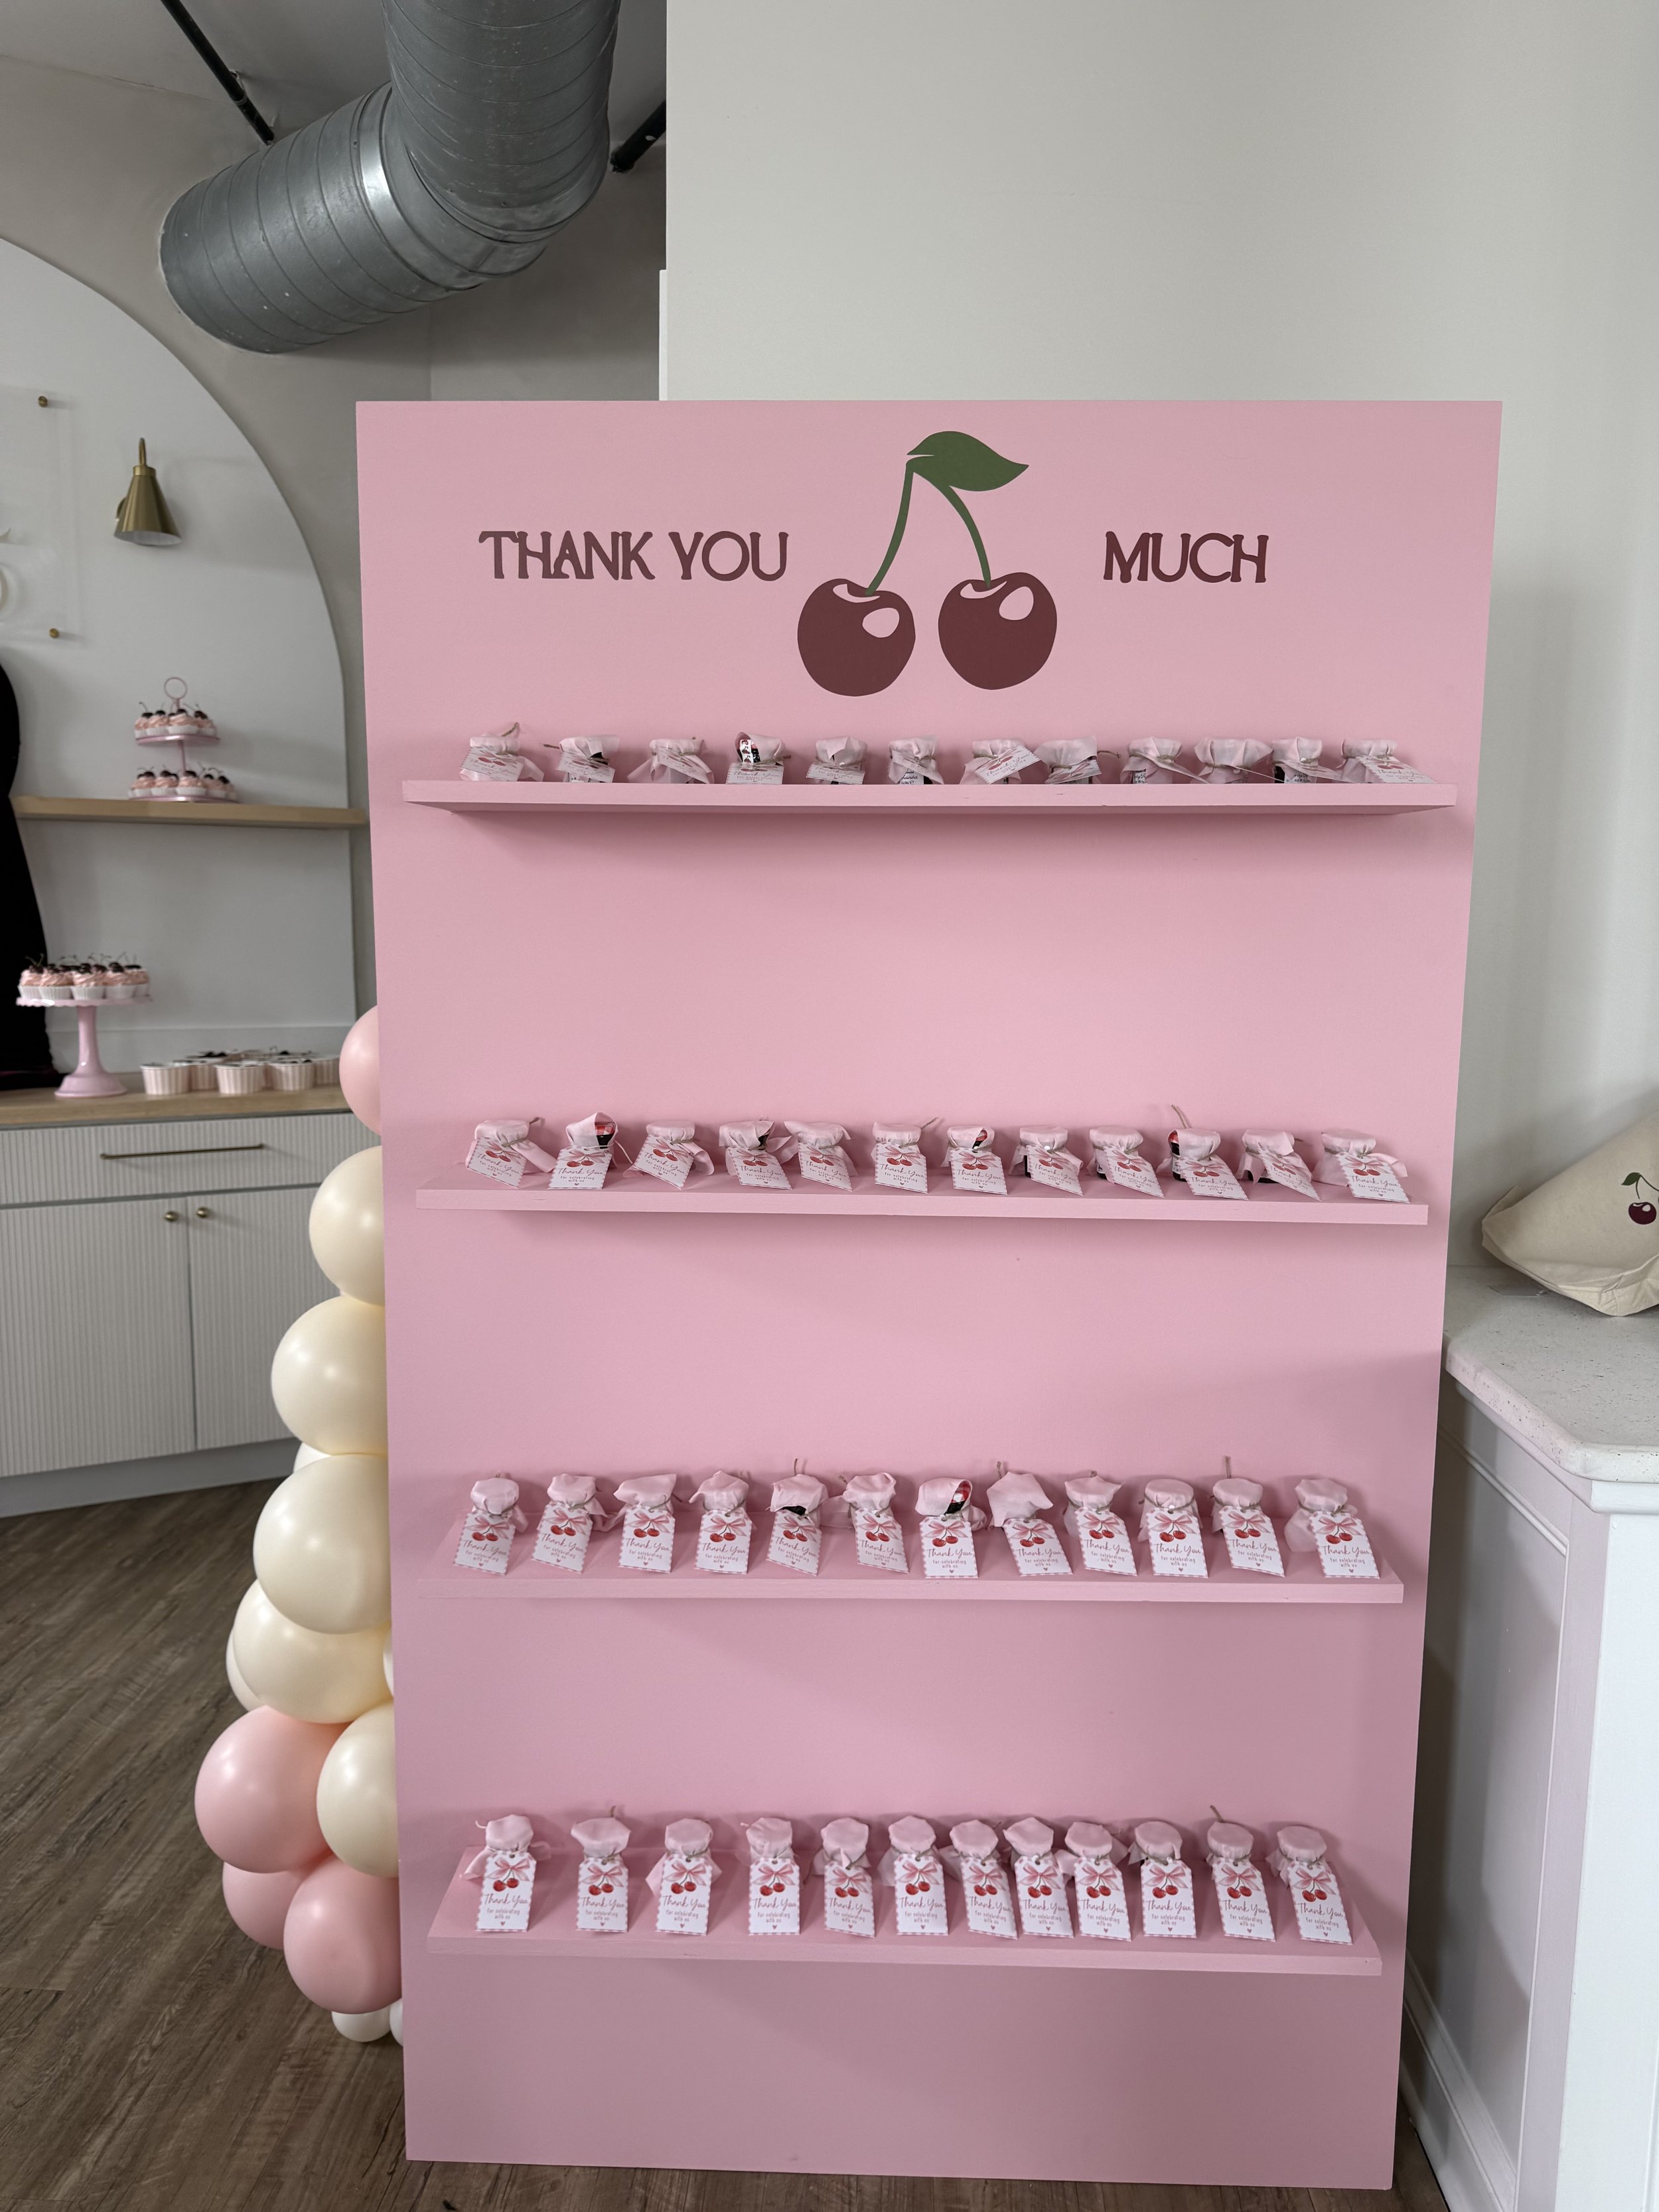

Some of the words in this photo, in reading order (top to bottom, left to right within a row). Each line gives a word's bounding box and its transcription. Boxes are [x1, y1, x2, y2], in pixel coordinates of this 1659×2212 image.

[478, 531, 655, 580] THANK
[668, 531, 788, 581] YOU
[1104, 532, 1269, 583] MUCH
[463, 1540, 488, 1550] Thank
[490, 1546, 506, 1555] You
[541, 1532, 566, 1546] Thank
[568, 1542, 583, 1551] You
[625, 1537, 652, 1548] Thank
[654, 1542, 670, 1552] You
[701, 1542, 728, 1552] Thank
[730, 1546, 746, 1555] You
[775, 1536, 800, 1549] Thank
[801, 1546, 816, 1556] You
[859, 1540, 885, 1551] Thank
[887, 1547, 902, 1556] You
[1084, 1538, 1111, 1550] Thank
[1113, 1544, 1129, 1554] You
[1153, 1542, 1182, 1553] Thank
[1184, 1546, 1200, 1556] You
[1230, 1538, 1258, 1549] Thank
[1260, 1543, 1276, 1552] You
[926, 1548, 953, 1557] Thank
[955, 1548, 972, 1558] You
[1015, 1548, 1043, 1556] Thank
[1045, 1548, 1061, 1557] You
[1321, 1545, 1350, 1554] Thank
[1352, 1546, 1369, 1557] You
[484, 1893, 510, 1904] Thank
[512, 1895, 528, 1907] You
[581, 1896, 607, 1907] Thank
[609, 1899, 624, 1910] You
[663, 1894, 688, 1907] Thank
[690, 1899, 706, 1911] You
[753, 1897, 778, 1909] Thank
[780, 1899, 796, 1911] You
[828, 1897, 853, 1909] Thank
[855, 1903, 871, 1914] You
[899, 1896, 925, 1907] Thank
[927, 1899, 943, 1911] You
[968, 1895, 993, 1909] Thank
[995, 1902, 1009, 1913] You
[1022, 1898, 1048, 1910] Thank
[1050, 1902, 1066, 1914] You
[1080, 1898, 1107, 1911] Thank
[1109, 1903, 1124, 1915] You
[1146, 1899, 1173, 1910] Thank
[1175, 1901, 1191, 1914] You
[1222, 1899, 1249, 1911] Thank
[1251, 1903, 1267, 1916] You
[1297, 1902, 1325, 1915] Thank
[1327, 1907, 1342, 1919] You
